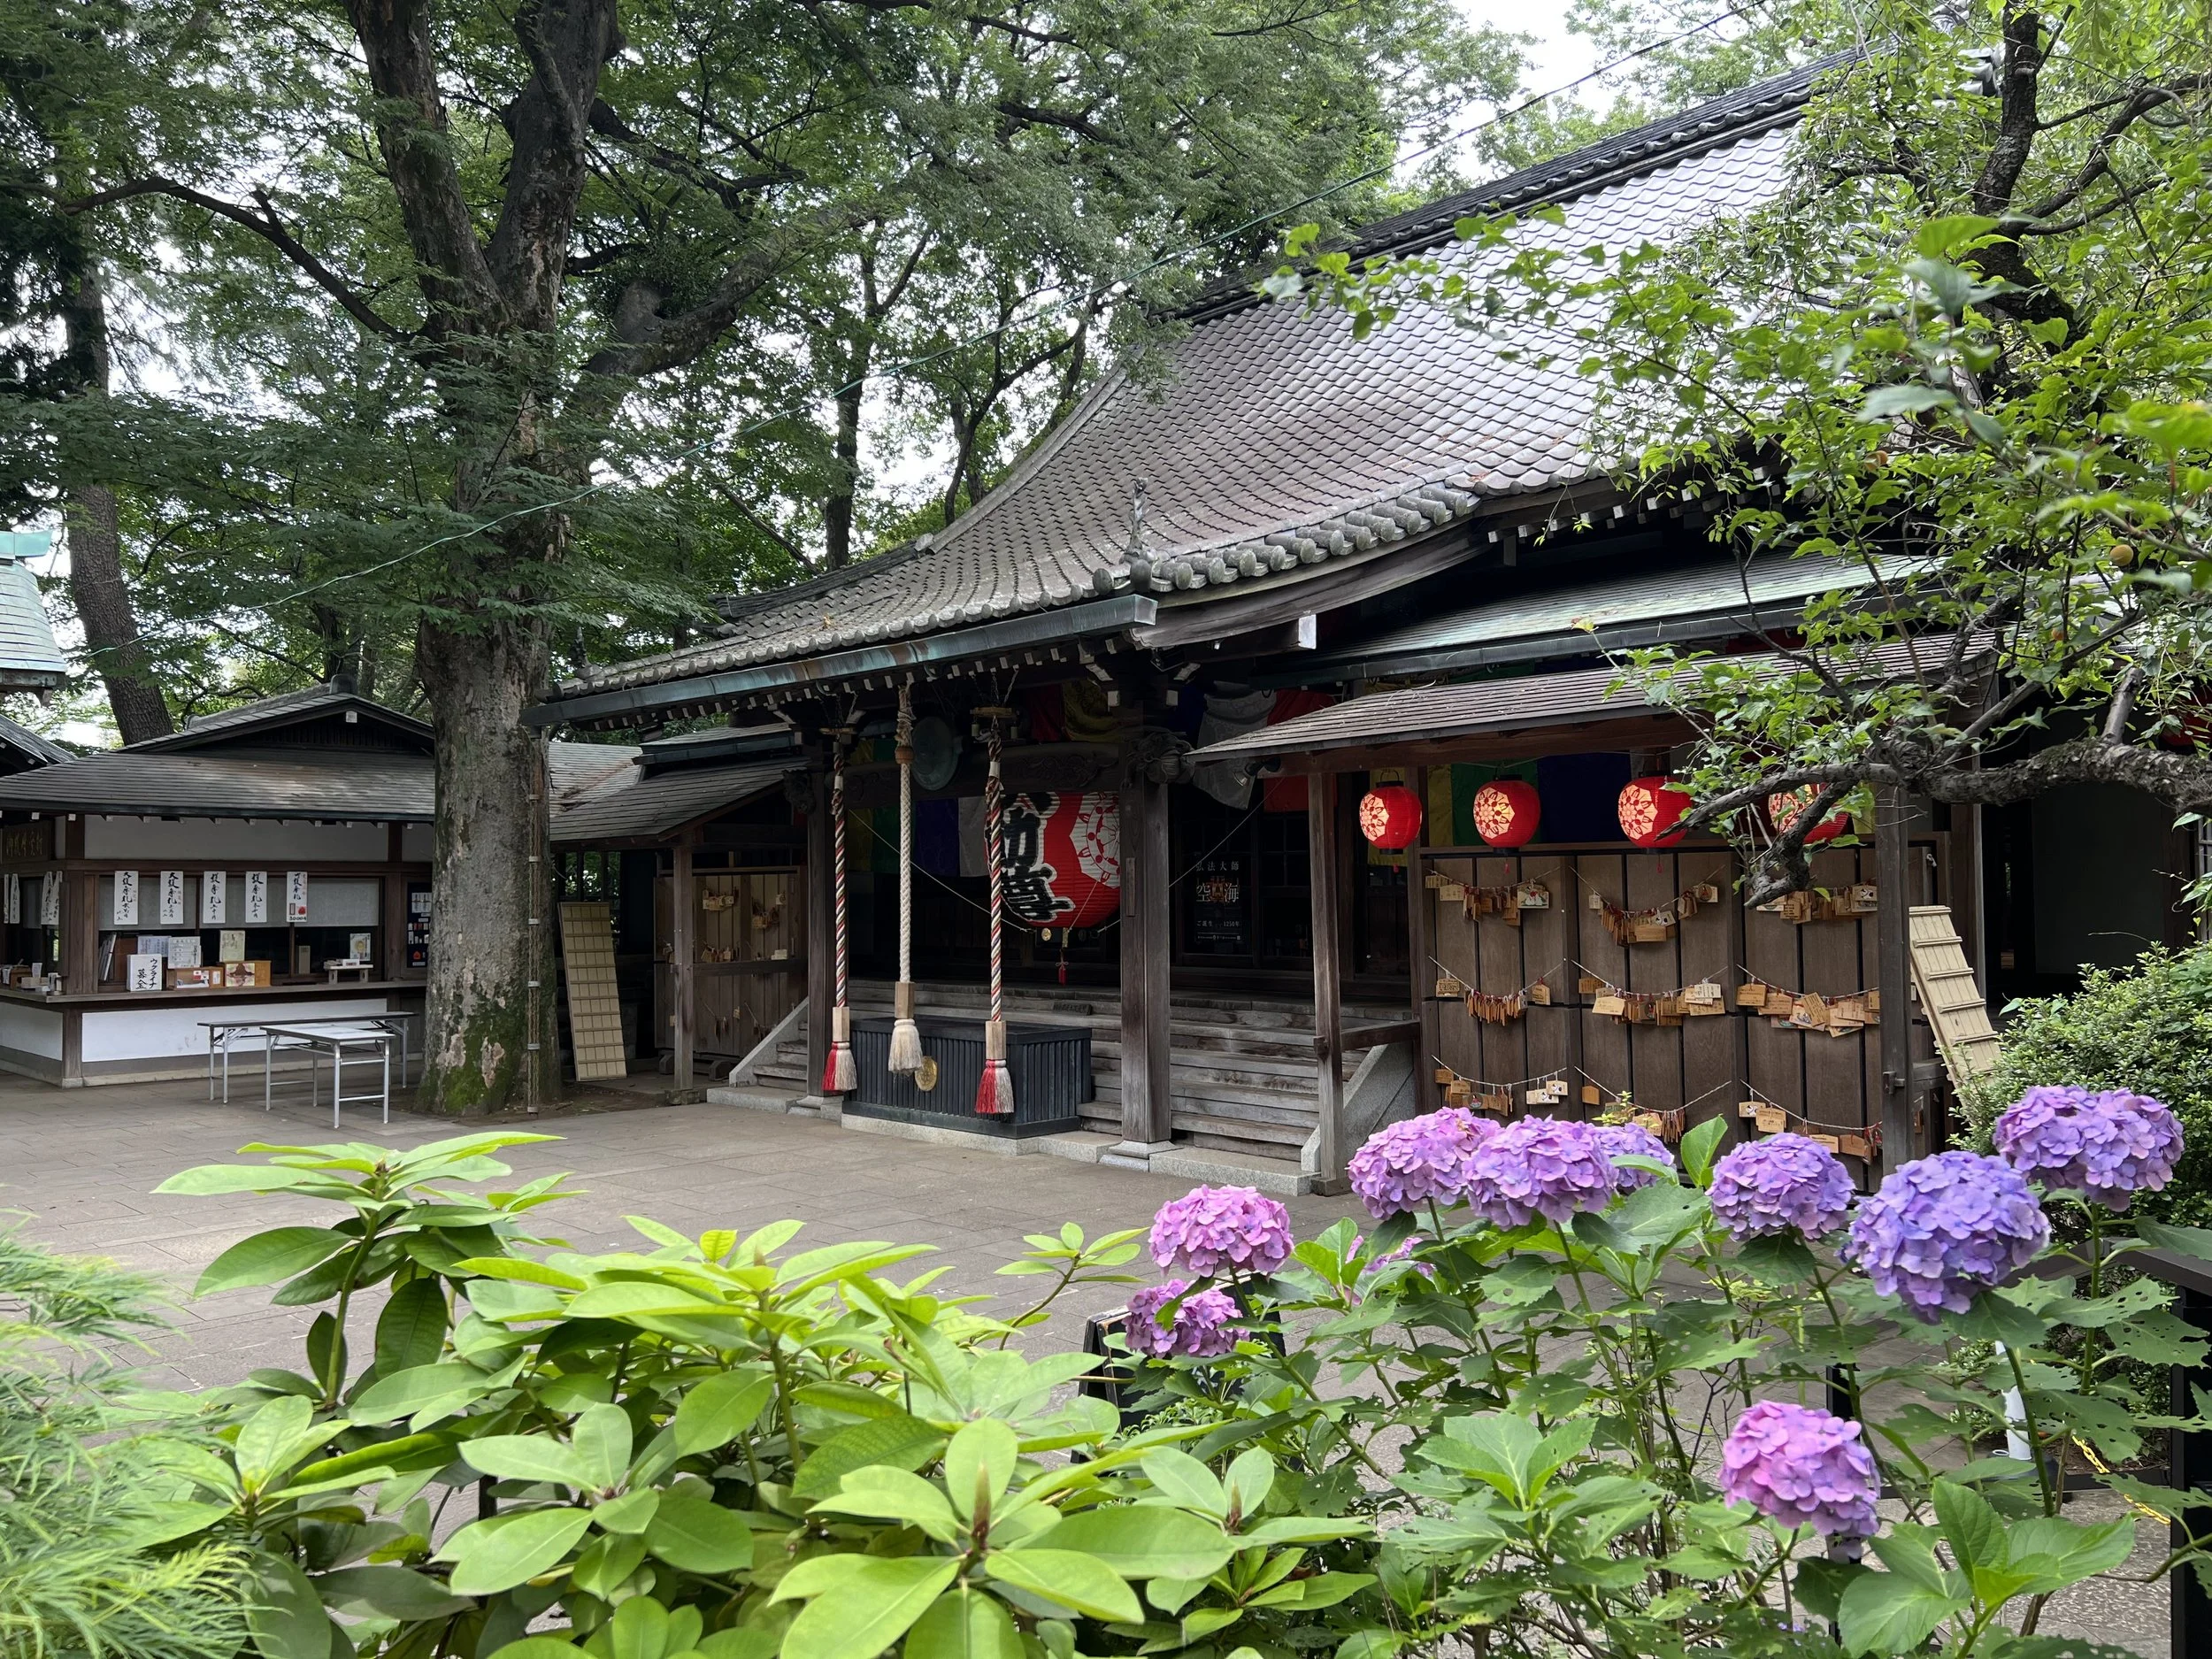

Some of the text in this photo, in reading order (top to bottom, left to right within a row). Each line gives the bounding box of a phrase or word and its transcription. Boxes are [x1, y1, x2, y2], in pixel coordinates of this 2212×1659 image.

[1195, 860, 1240, 872] 弘法大師
[1196, 882, 1240, 902] 空海
[135, 968, 148, 989] 募金
[149, 958, 157, 989] ウクライナ
